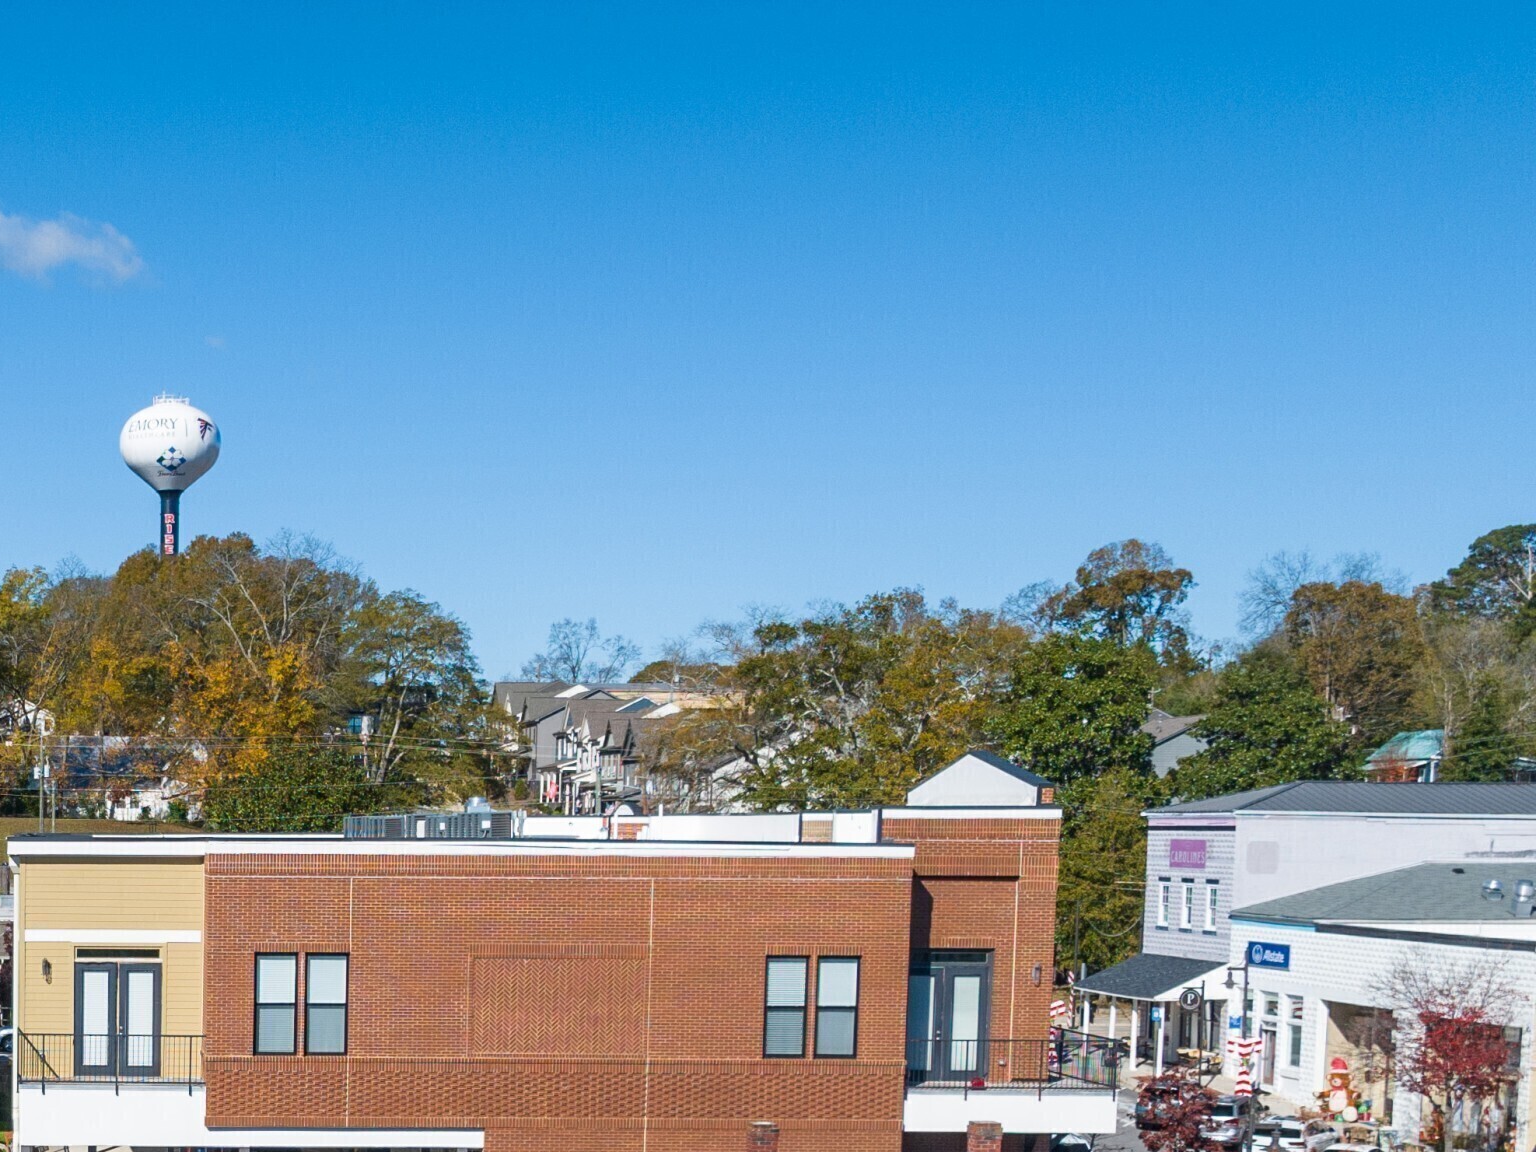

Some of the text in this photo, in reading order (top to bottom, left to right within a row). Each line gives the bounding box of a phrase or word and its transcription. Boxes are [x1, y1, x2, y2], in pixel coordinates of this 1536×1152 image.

[128, 418, 179, 433] EMORY
[164, 513, 175, 555] RISE
[1186, 993, 1195, 1005] P
